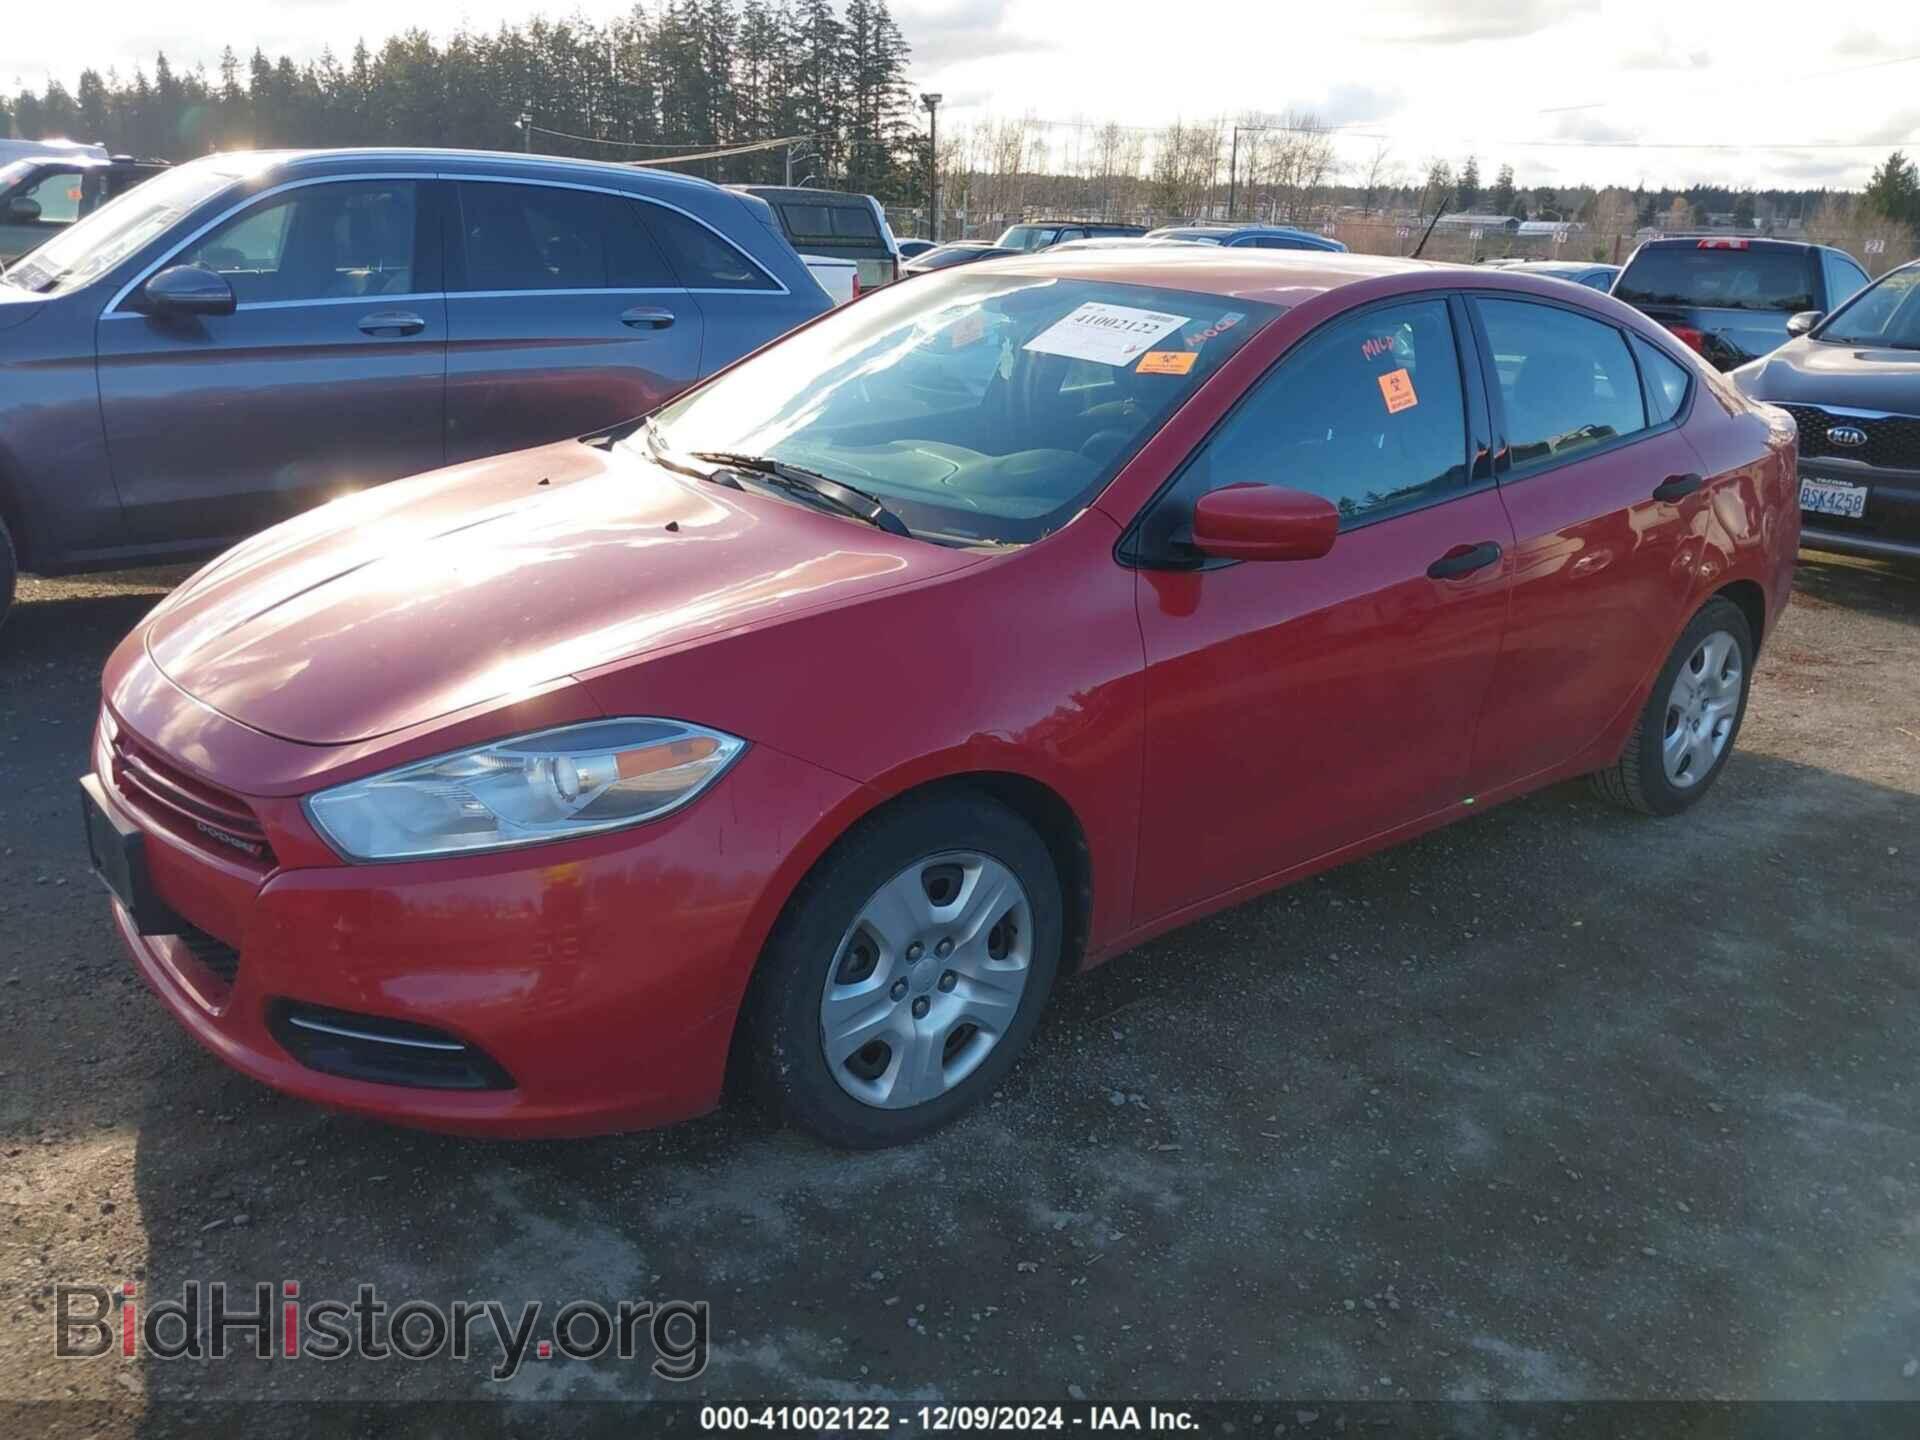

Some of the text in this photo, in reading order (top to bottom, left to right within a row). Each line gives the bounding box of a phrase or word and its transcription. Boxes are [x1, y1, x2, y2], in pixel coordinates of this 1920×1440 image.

[1074, 314, 1160, 334] 41002122
[1833, 429, 1859, 443] KIA
[1800, 487, 1863, 511] BSK4258
